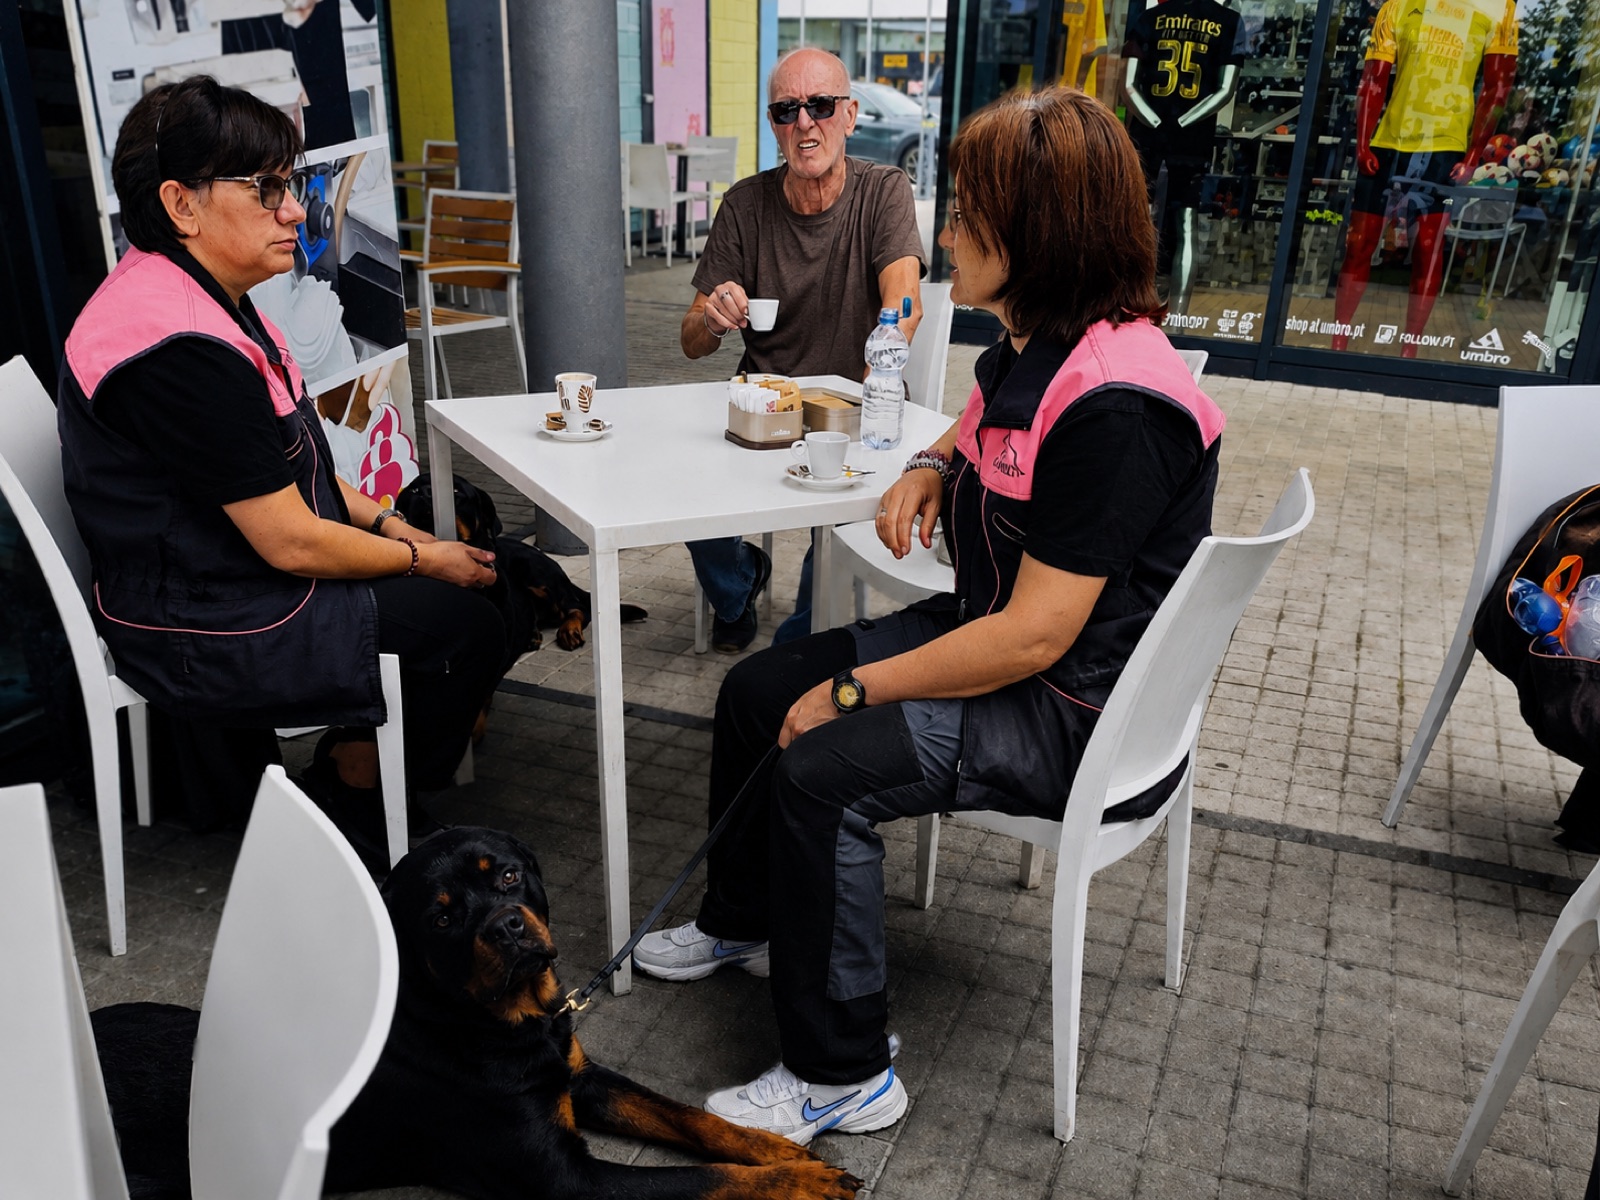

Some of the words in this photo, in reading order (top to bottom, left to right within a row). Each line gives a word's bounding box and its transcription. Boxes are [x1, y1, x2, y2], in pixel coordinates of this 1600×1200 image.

[1155, 13, 1222, 37] Emirates
[1151, 39, 1208, 99] 35
[1285, 315, 1308, 335] shop
[1320, 320, 1366, 340] umbro.pt
[1460, 350, 1511, 365] umbro
